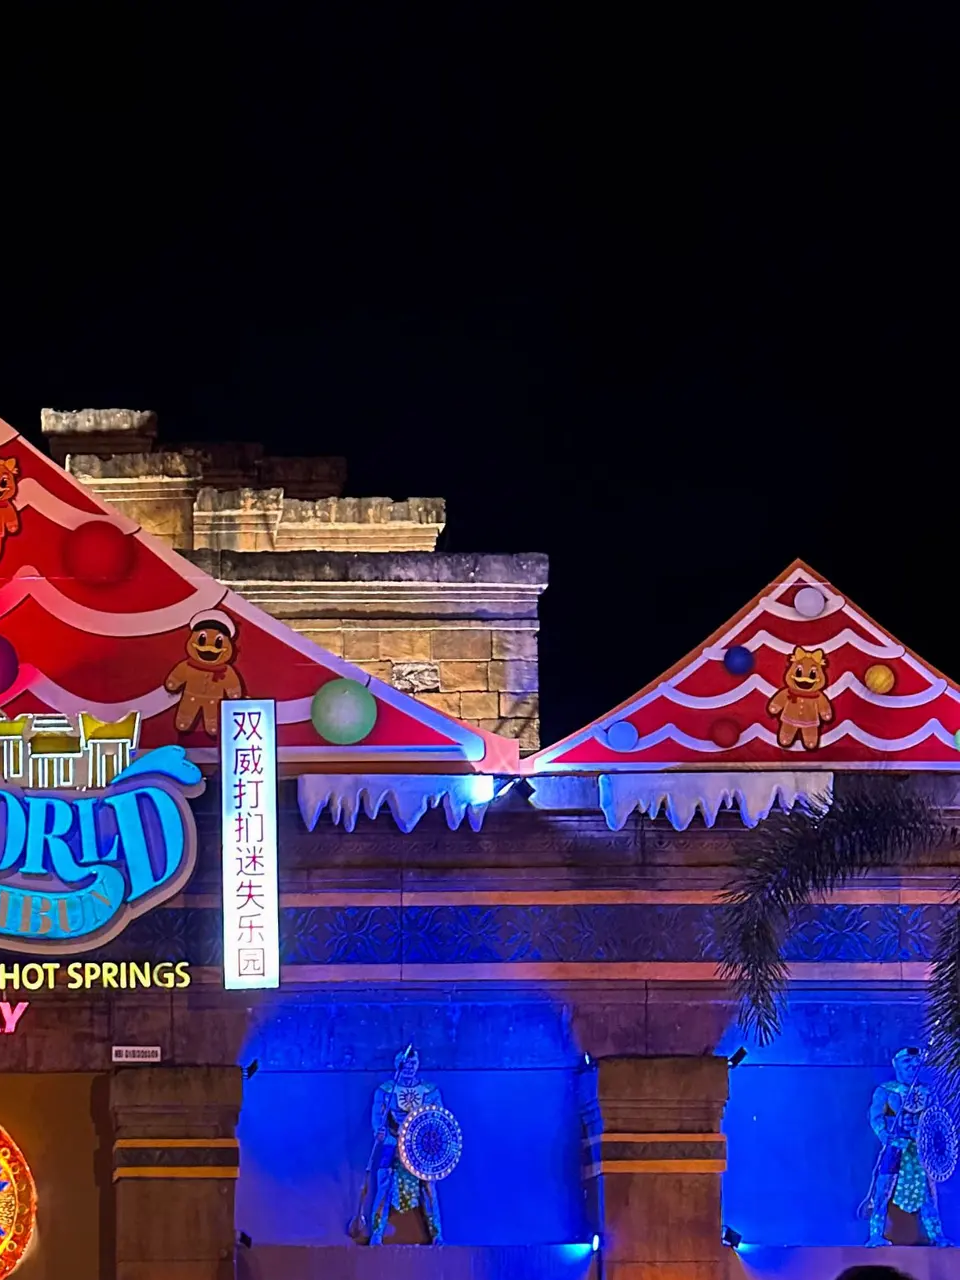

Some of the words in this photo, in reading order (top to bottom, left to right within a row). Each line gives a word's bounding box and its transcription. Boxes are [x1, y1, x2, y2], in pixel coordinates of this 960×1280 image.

[232, 710, 266, 978] 双威打扪迷失乐园
[0, 963, 60, 990] HOT
[67, 962, 190, 989] SPRINGS
